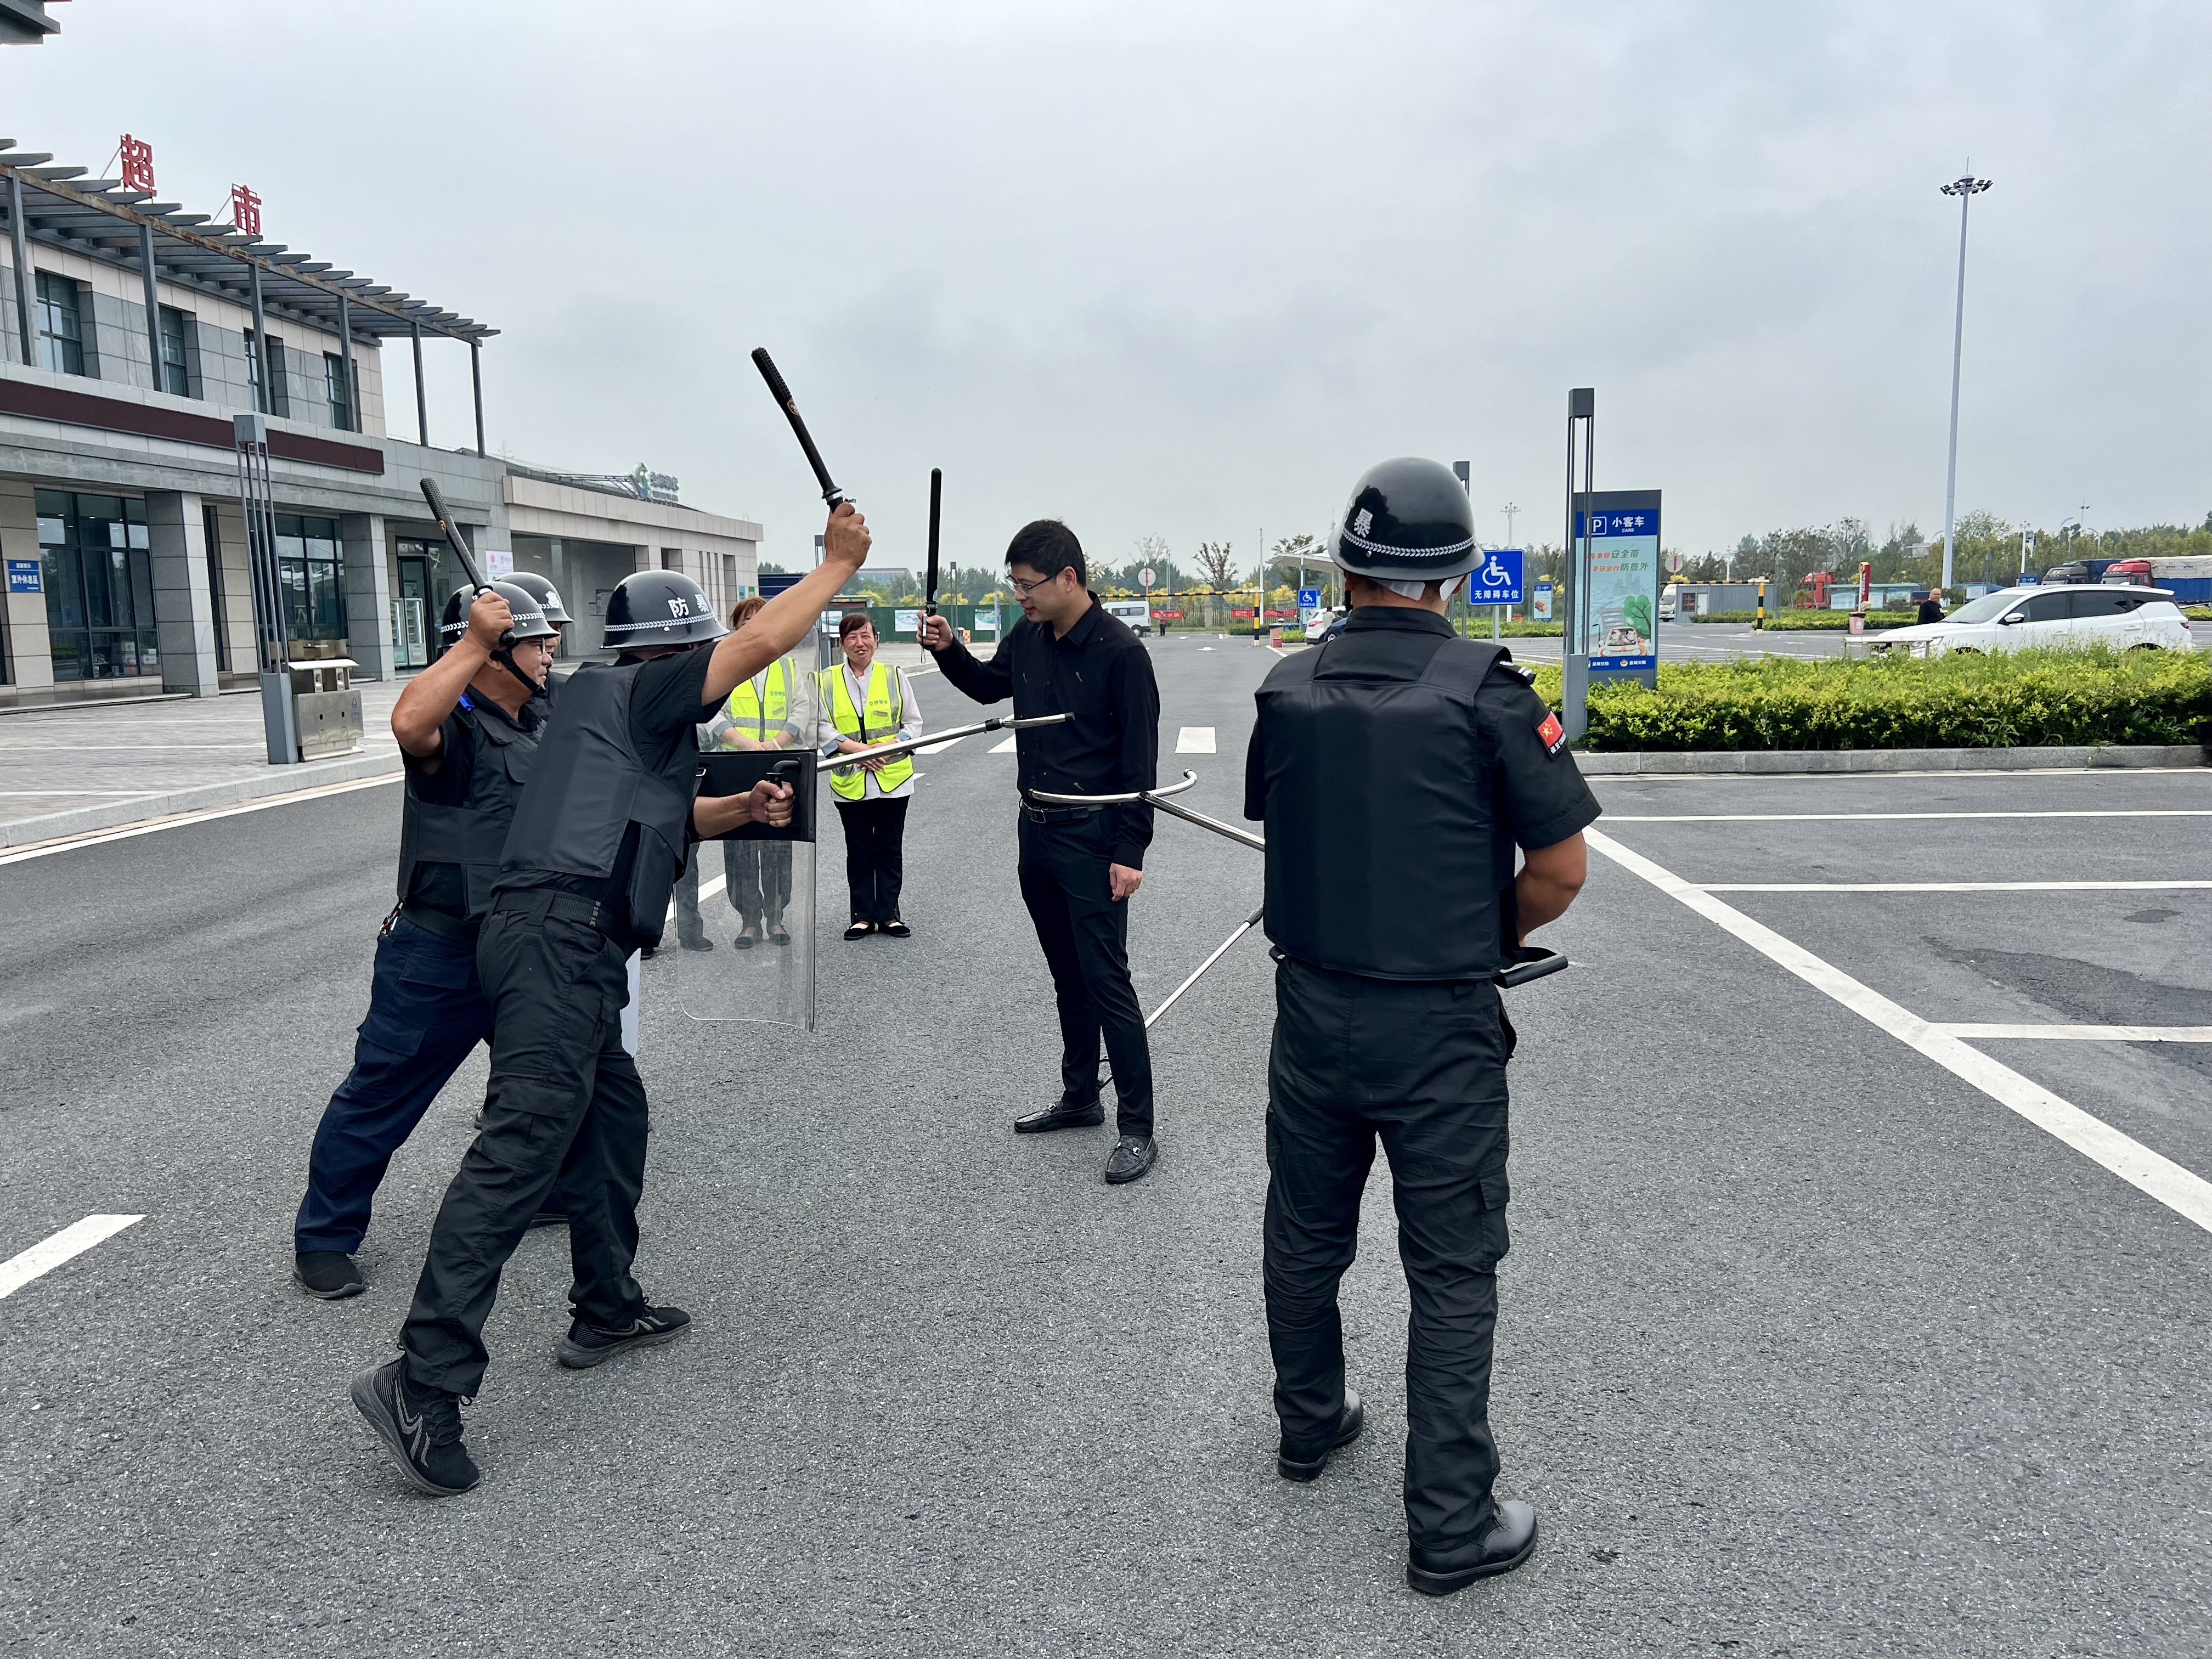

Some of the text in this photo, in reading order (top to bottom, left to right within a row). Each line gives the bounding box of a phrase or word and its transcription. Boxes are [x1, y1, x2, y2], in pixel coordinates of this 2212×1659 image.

[120, 133, 262, 236] 超市
[1611, 516, 1645, 528] 小客车
[1474, 589, 1519, 600] 无障碍车位
[667, 594, 709, 619] 防暴
